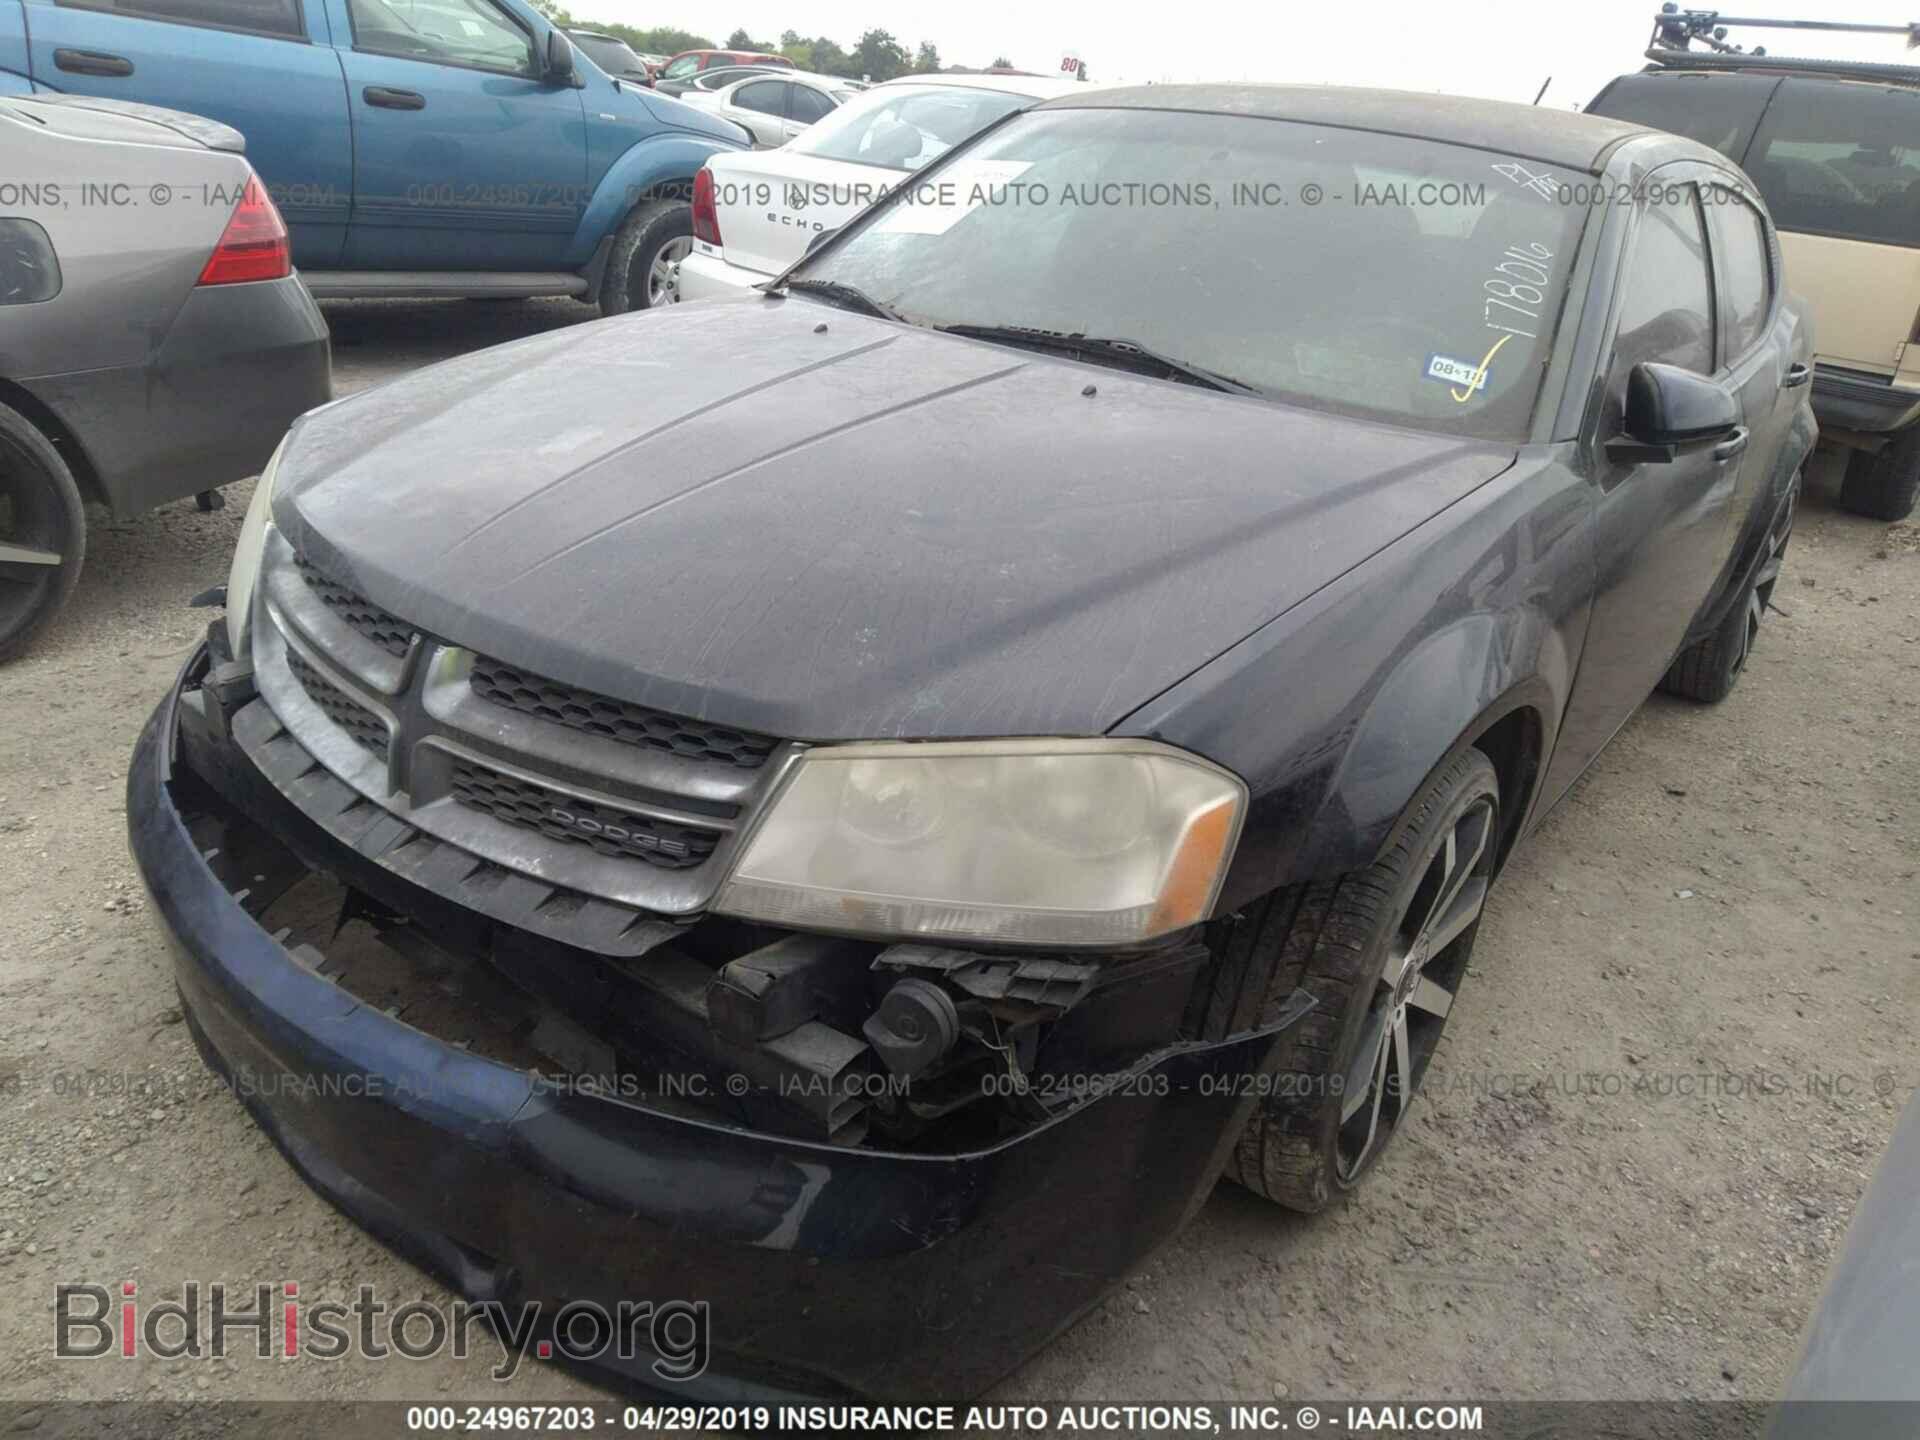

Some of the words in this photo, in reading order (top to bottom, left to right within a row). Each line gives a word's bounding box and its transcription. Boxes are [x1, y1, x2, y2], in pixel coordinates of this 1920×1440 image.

[1060, 57, 1078, 72] 80
[767, 212, 824, 232] ECHO
[551, 808, 687, 856] DODGE
